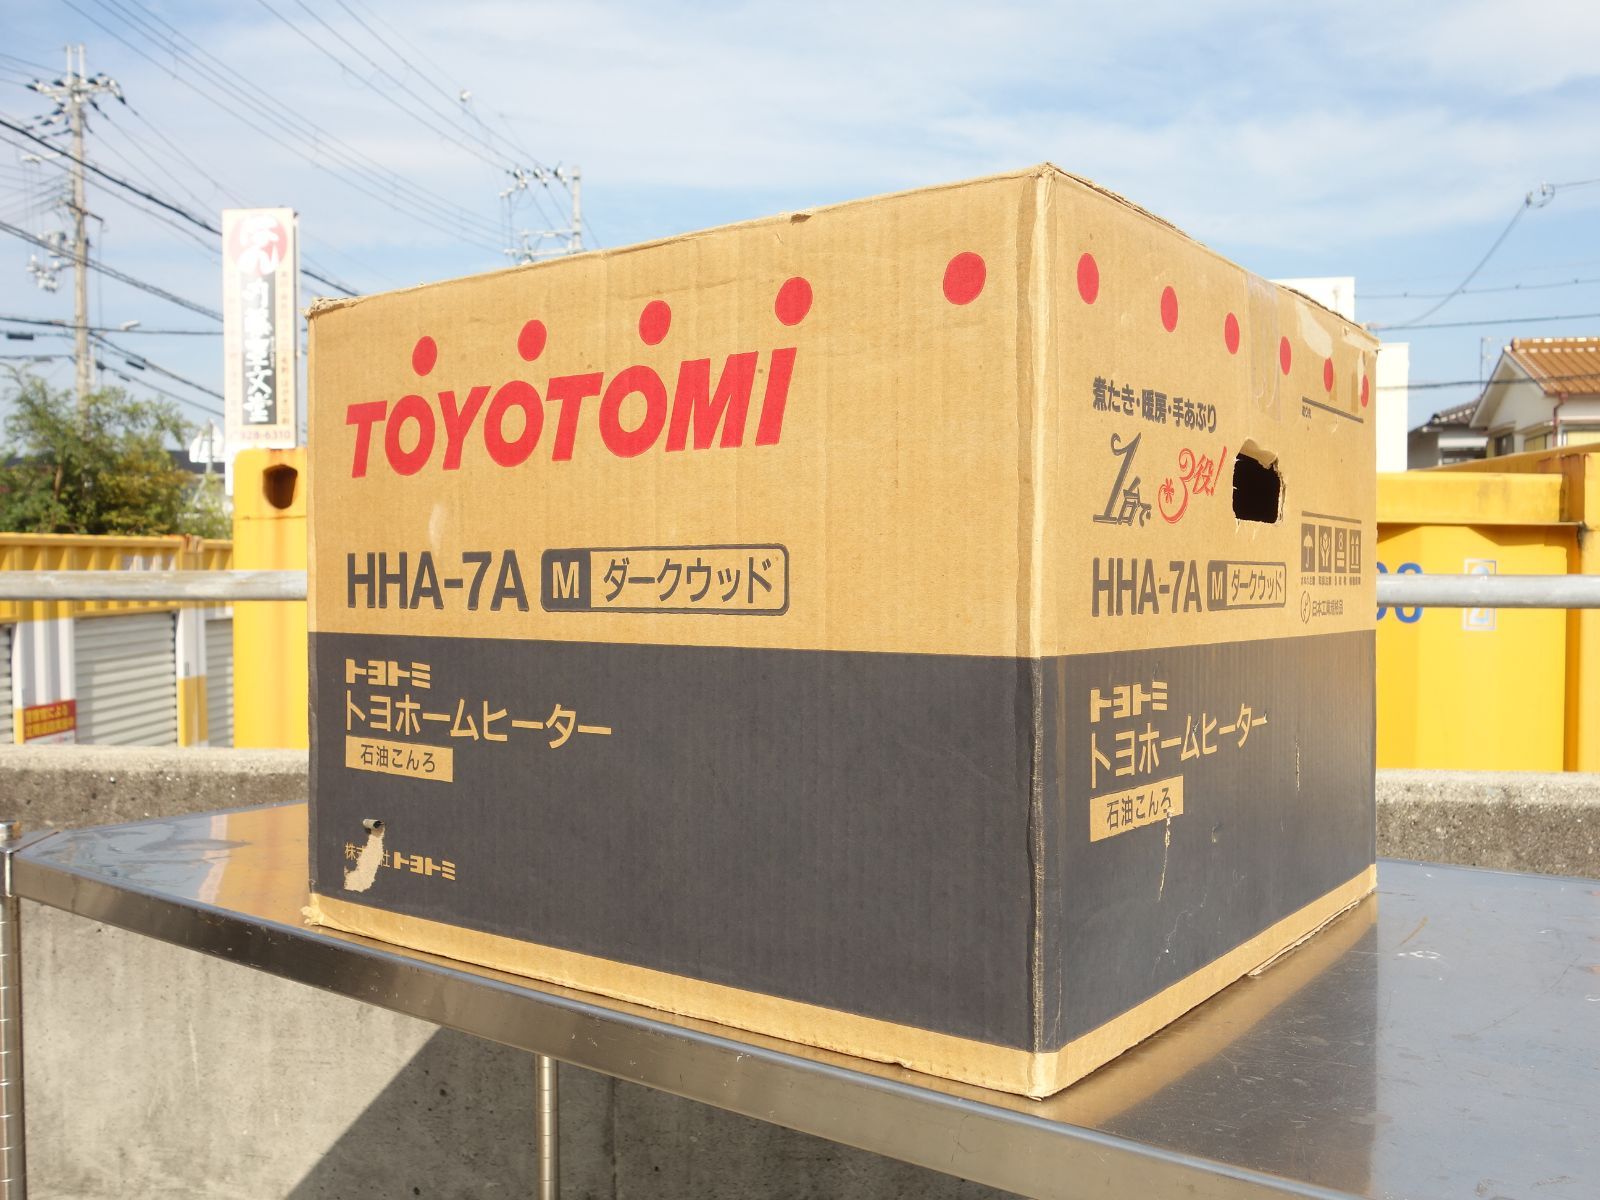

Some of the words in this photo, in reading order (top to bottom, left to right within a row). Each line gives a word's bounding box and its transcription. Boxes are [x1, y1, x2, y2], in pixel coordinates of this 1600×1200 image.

[345, 347, 798, 478] TOYOTOMI
[1092, 376, 1217, 433] 煮たき・暖房・手あぶり
[347, 549, 530, 611] HHA-7A
[551, 561, 581, 600] M
[603, 556, 773, 604] ダークウッド
[1092, 557, 1203, 617] HHA-7A
[1211, 571, 1224, 600] M
[1230, 569, 1283, 601] ダークウッド
[345, 658, 431, 689] トヨトミ
[1090, 681, 1168, 723] トヨトミ
[346, 689, 612, 749] トヨホームヒーター
[1091, 703, 1268, 789] トヨホームヒーター
[360, 743, 436, 773] 石油こんろ
[1106, 787, 1173, 831] 石油こんろ
[344, 841, 391, 868] 株社
[393, 851, 456, 881] トヨトミ
